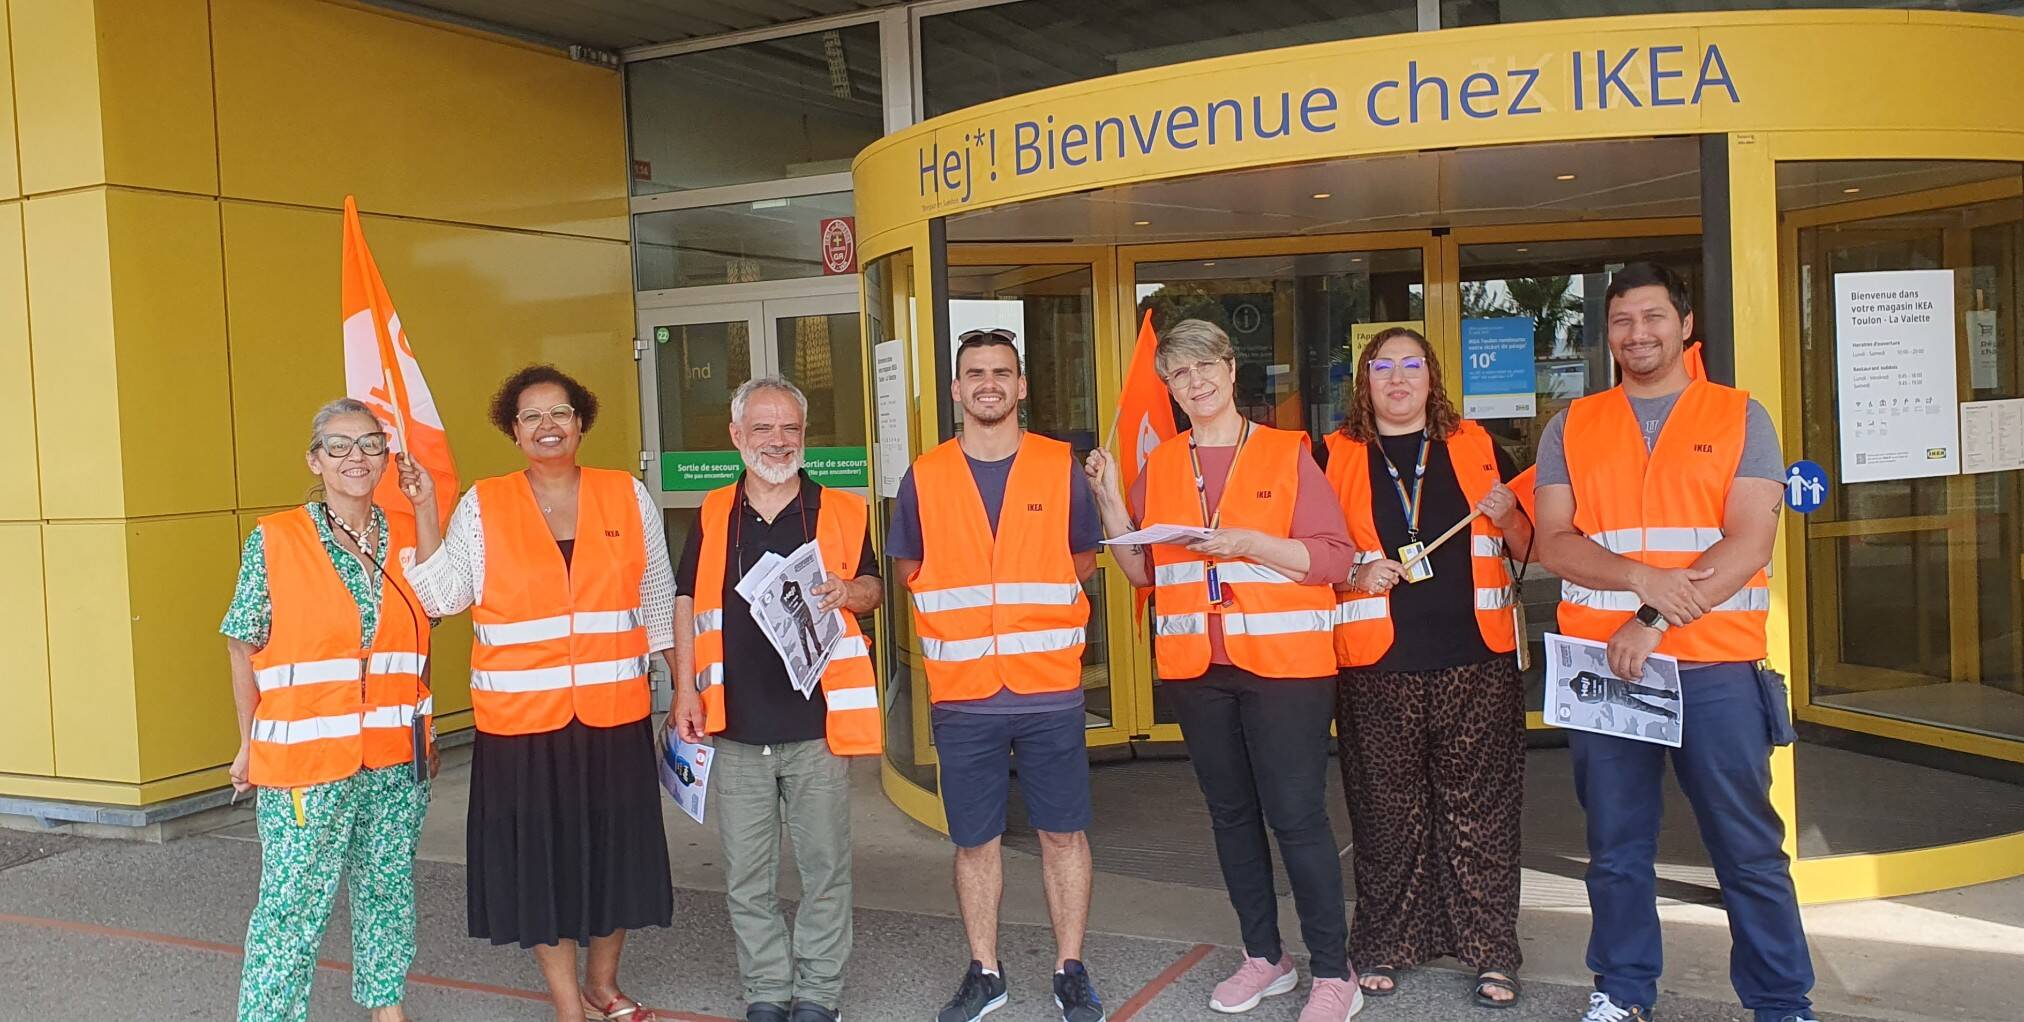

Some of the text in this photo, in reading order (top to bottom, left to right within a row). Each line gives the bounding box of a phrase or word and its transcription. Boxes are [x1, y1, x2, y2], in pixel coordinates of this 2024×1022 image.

[1013, 87, 1338, 177] Bienvenue
[1367, 61, 1542, 127] chez
[1572, 44, 1740, 110] IKEA
[1851, 290, 1919, 301] Bienvenue dans
[1851, 301, 1933, 314] votre magasin IKEA
[1851, 316, 1882, 326] Toulon
[1889, 315, 1899, 324] La
[1900, 314, 1931, 323] Valette
[1469, 351, 1497, 369] 10€
[1694, 444, 1713, 453] IKEA
[677, 463, 699, 472] Sortie
[700, 463, 710, 472] de
[801, 459, 825, 468] Sortie
[825, 459, 836, 468] de
[1256, 490, 1272, 499] IKEA
[1027, 503, 1043, 512] IKEA
